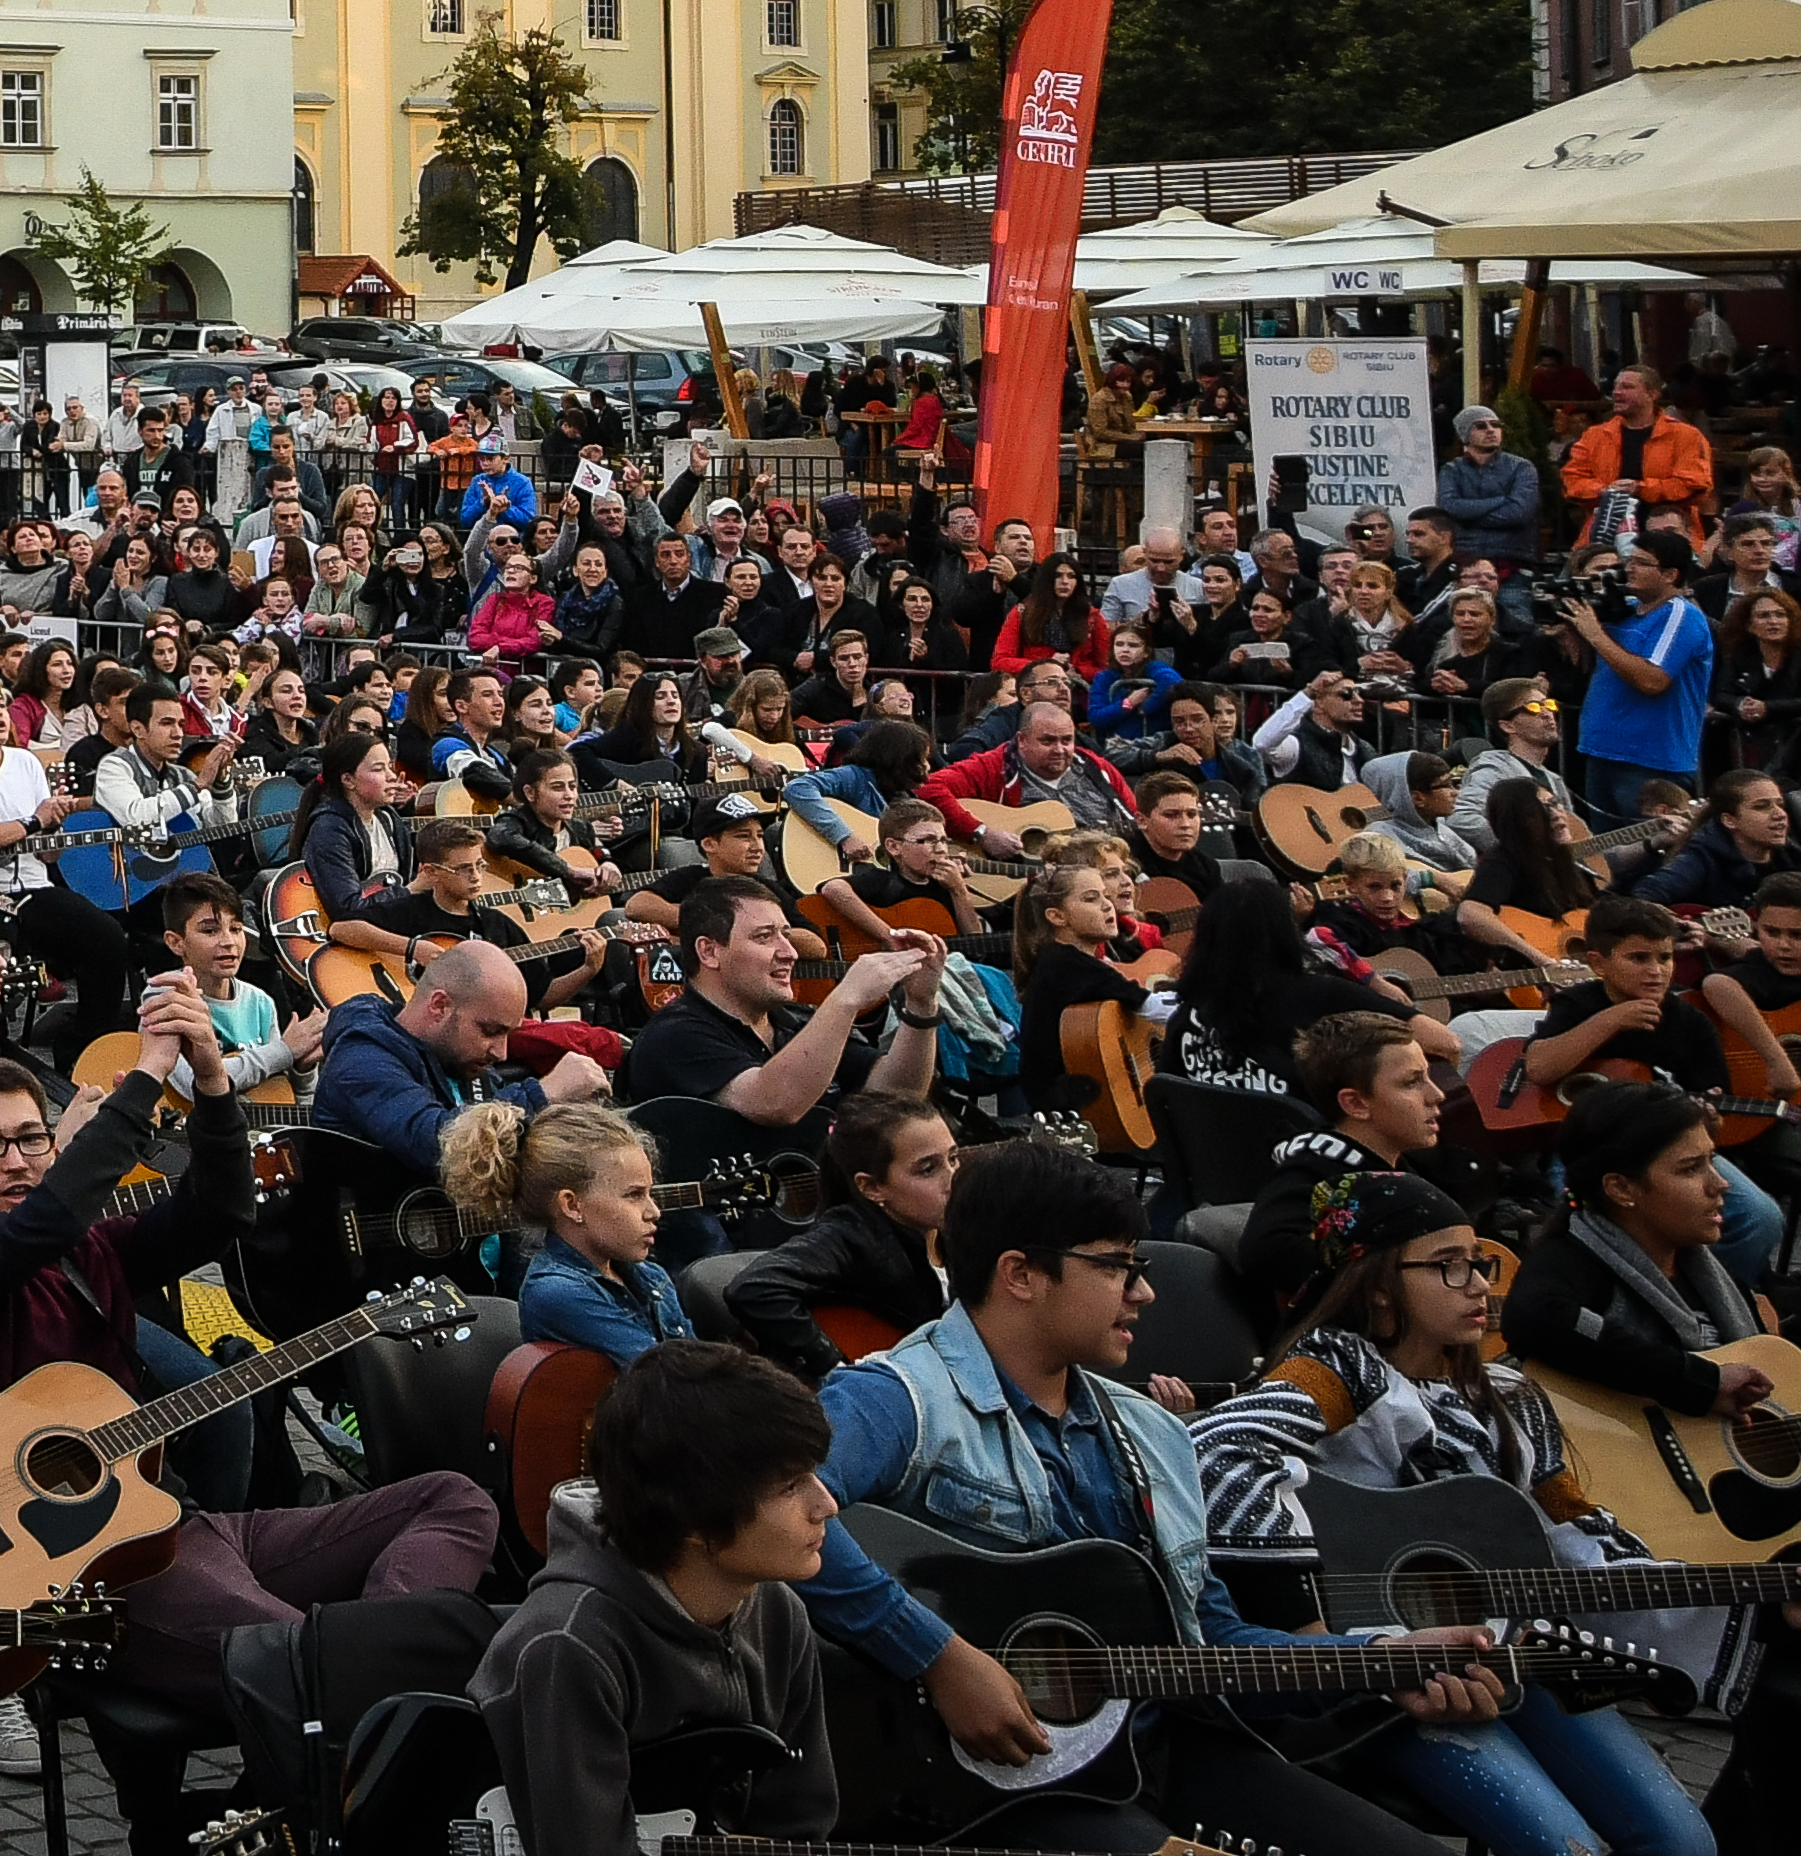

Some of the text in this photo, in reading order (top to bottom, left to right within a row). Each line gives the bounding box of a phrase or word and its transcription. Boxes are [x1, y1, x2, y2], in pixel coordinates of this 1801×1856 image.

[1331, 270, 1400, 290] WC WC
[1254, 353, 1302, 368] Rotary
[1387, 351, 1416, 361] CLUB
[1271, 396, 1411, 419] ROTARY CLUB
[1309, 425, 1376, 448] SIBIU
[652, 971, 683, 982] CAMP
